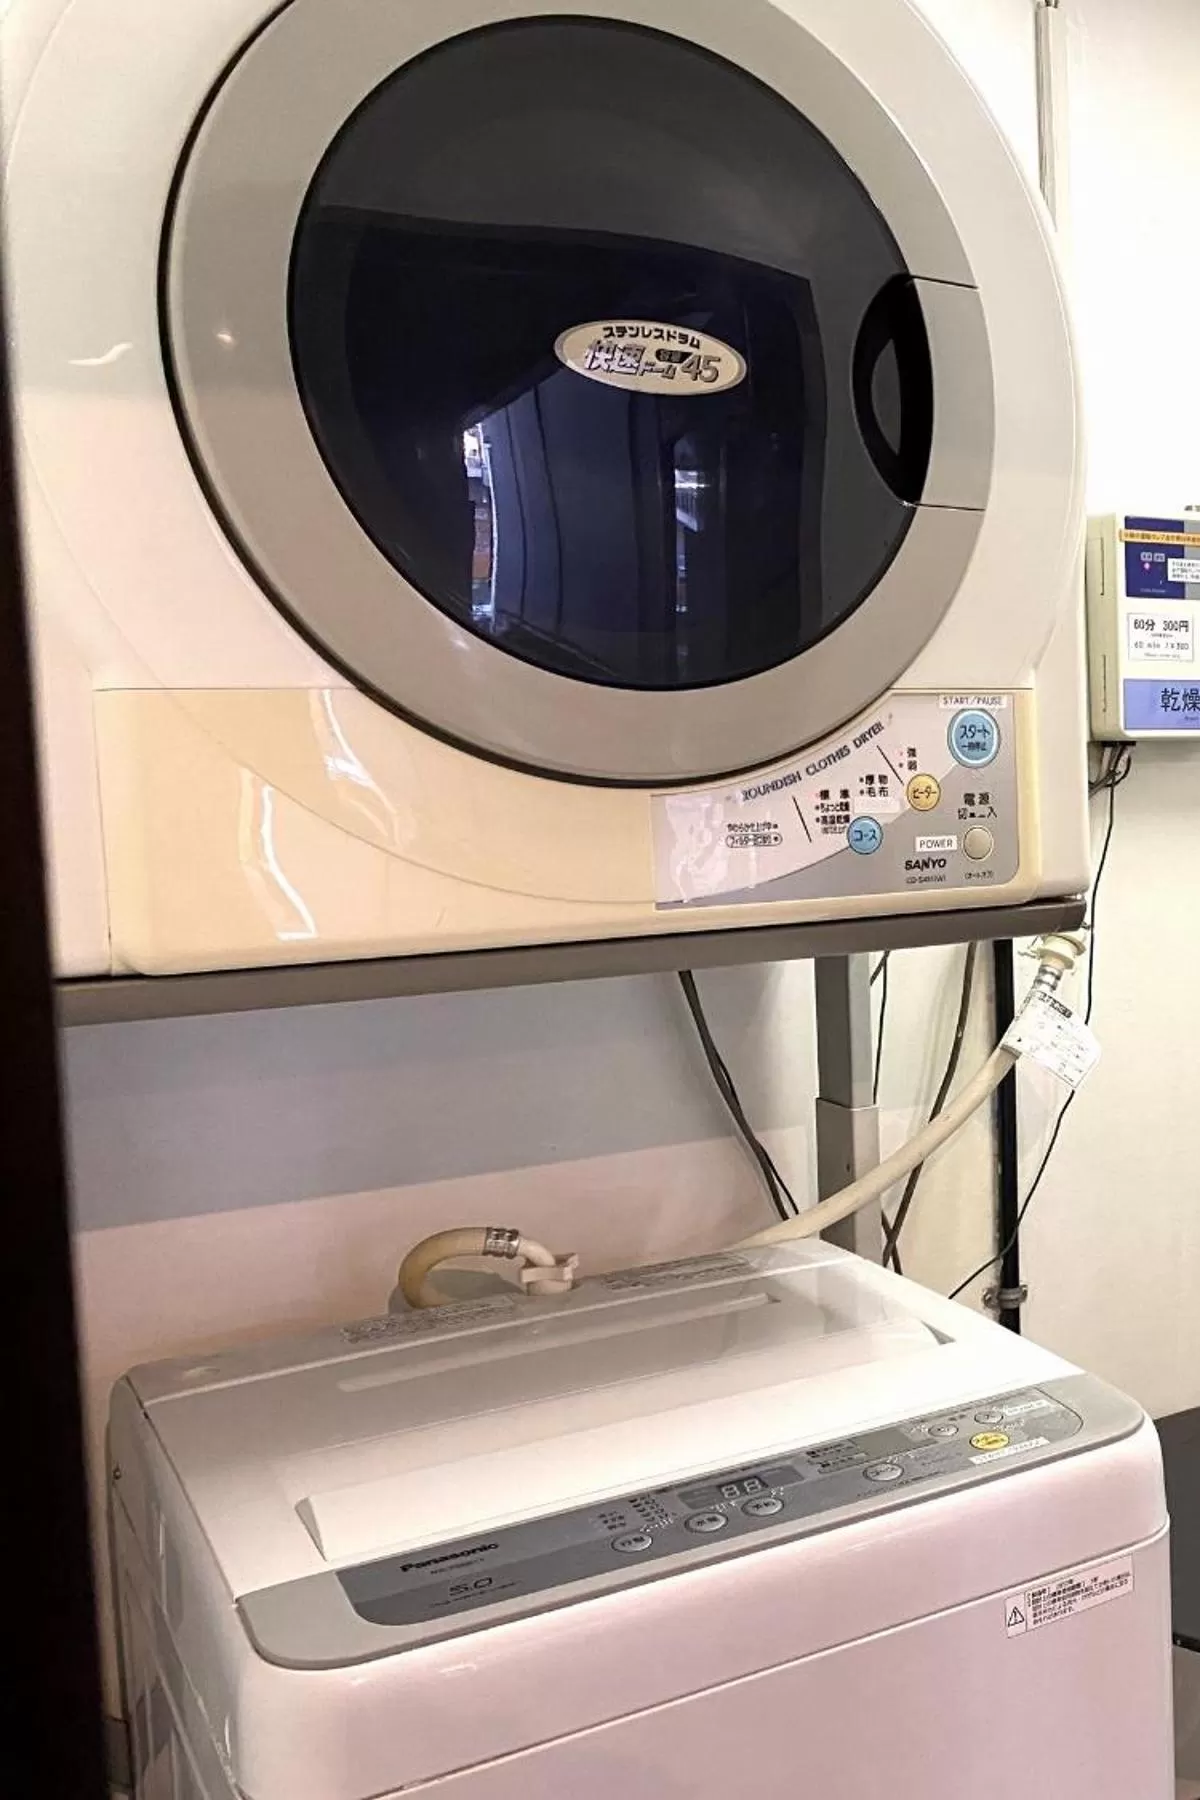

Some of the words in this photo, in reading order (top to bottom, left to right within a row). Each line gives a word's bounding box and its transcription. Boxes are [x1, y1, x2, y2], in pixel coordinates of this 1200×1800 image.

[602, 326, 700, 349] ステンレスドラム
[960, 724, 991, 739] スタート
[806, 745, 851, 776] CLOTHES
[912, 785, 937, 799] ヒーター
[853, 829, 878, 842] コース
[919, 839, 953, 849] POWER
[904, 857, 947, 871] SANYO
[399, 1543, 499, 1572] Panasonic
